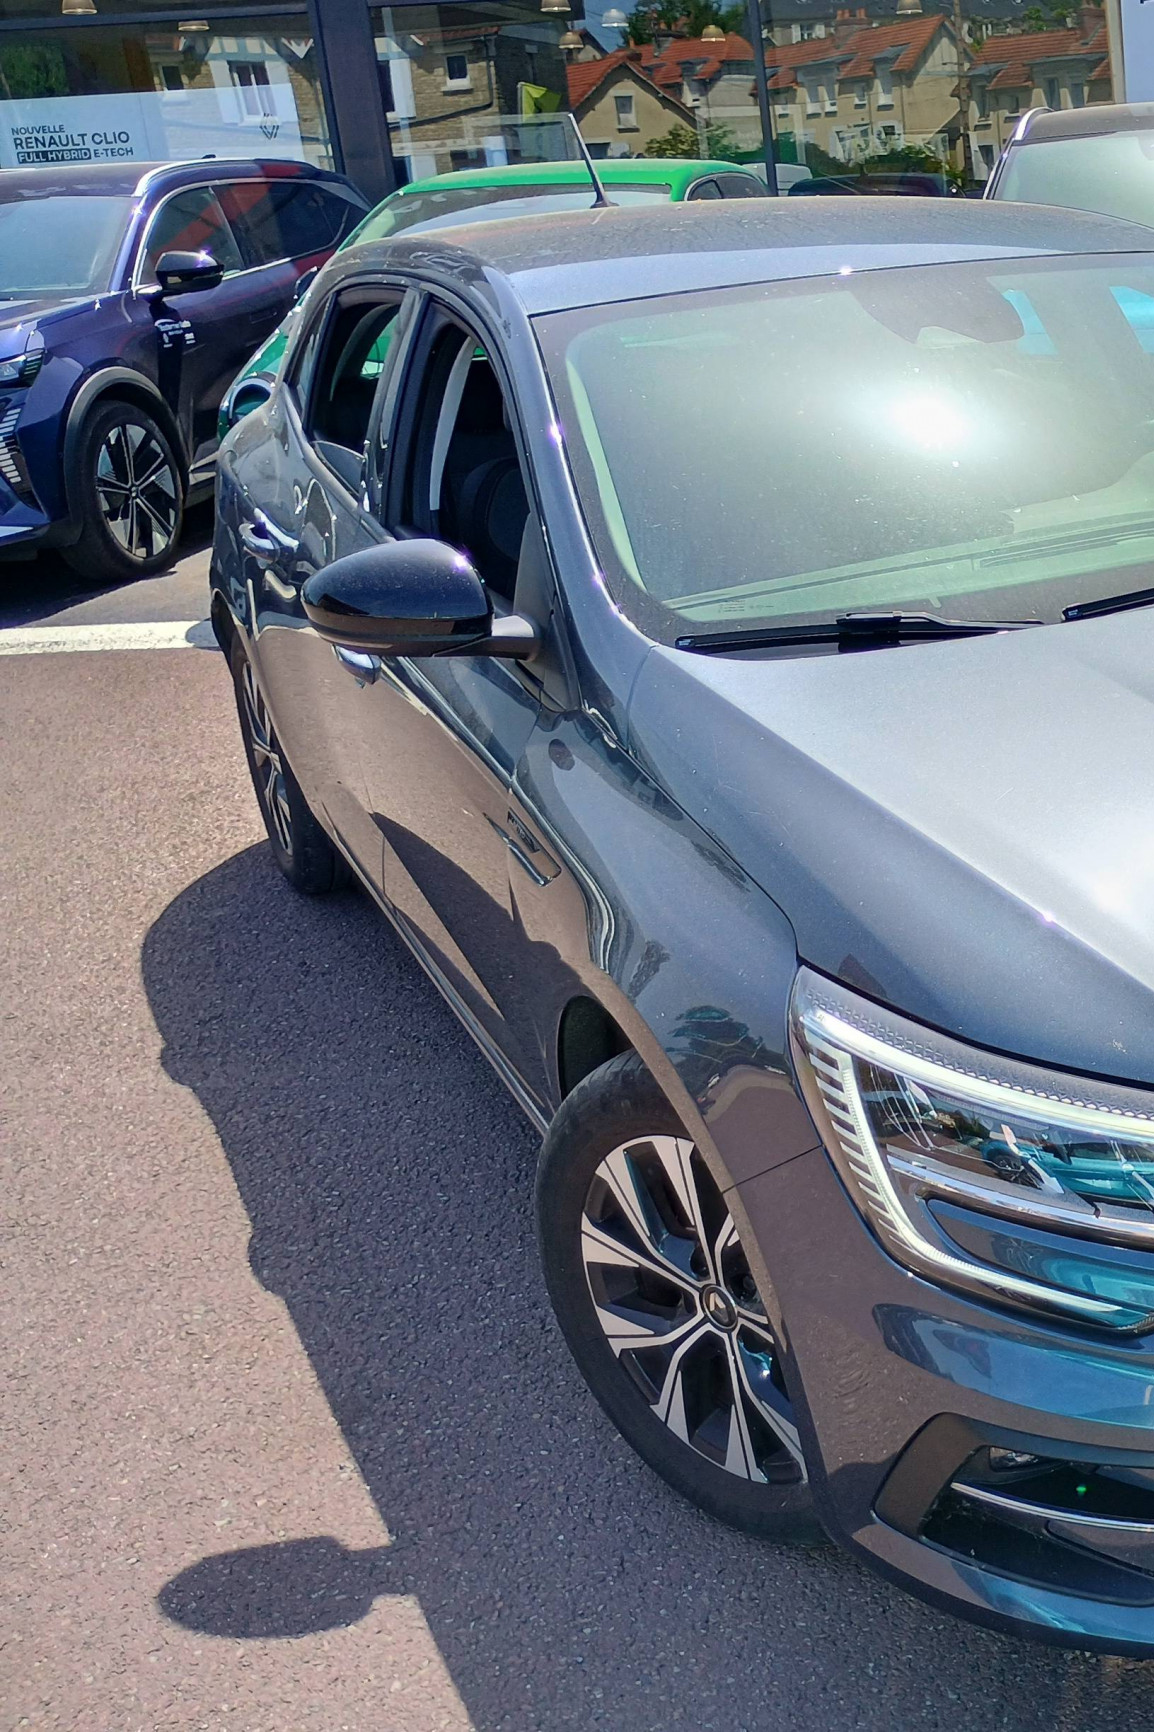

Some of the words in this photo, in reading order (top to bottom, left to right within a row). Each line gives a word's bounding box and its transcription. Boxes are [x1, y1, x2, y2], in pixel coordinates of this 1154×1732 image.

[11, 124, 66, 136] NOUVELLE
[13, 133, 87, 150] RENAULT
[91, 131, 130, 145] CLIO
[19, 151, 47, 162] FULL
[47, 149, 91, 161] HYBRID
[93, 147, 134, 158] E-TECH
